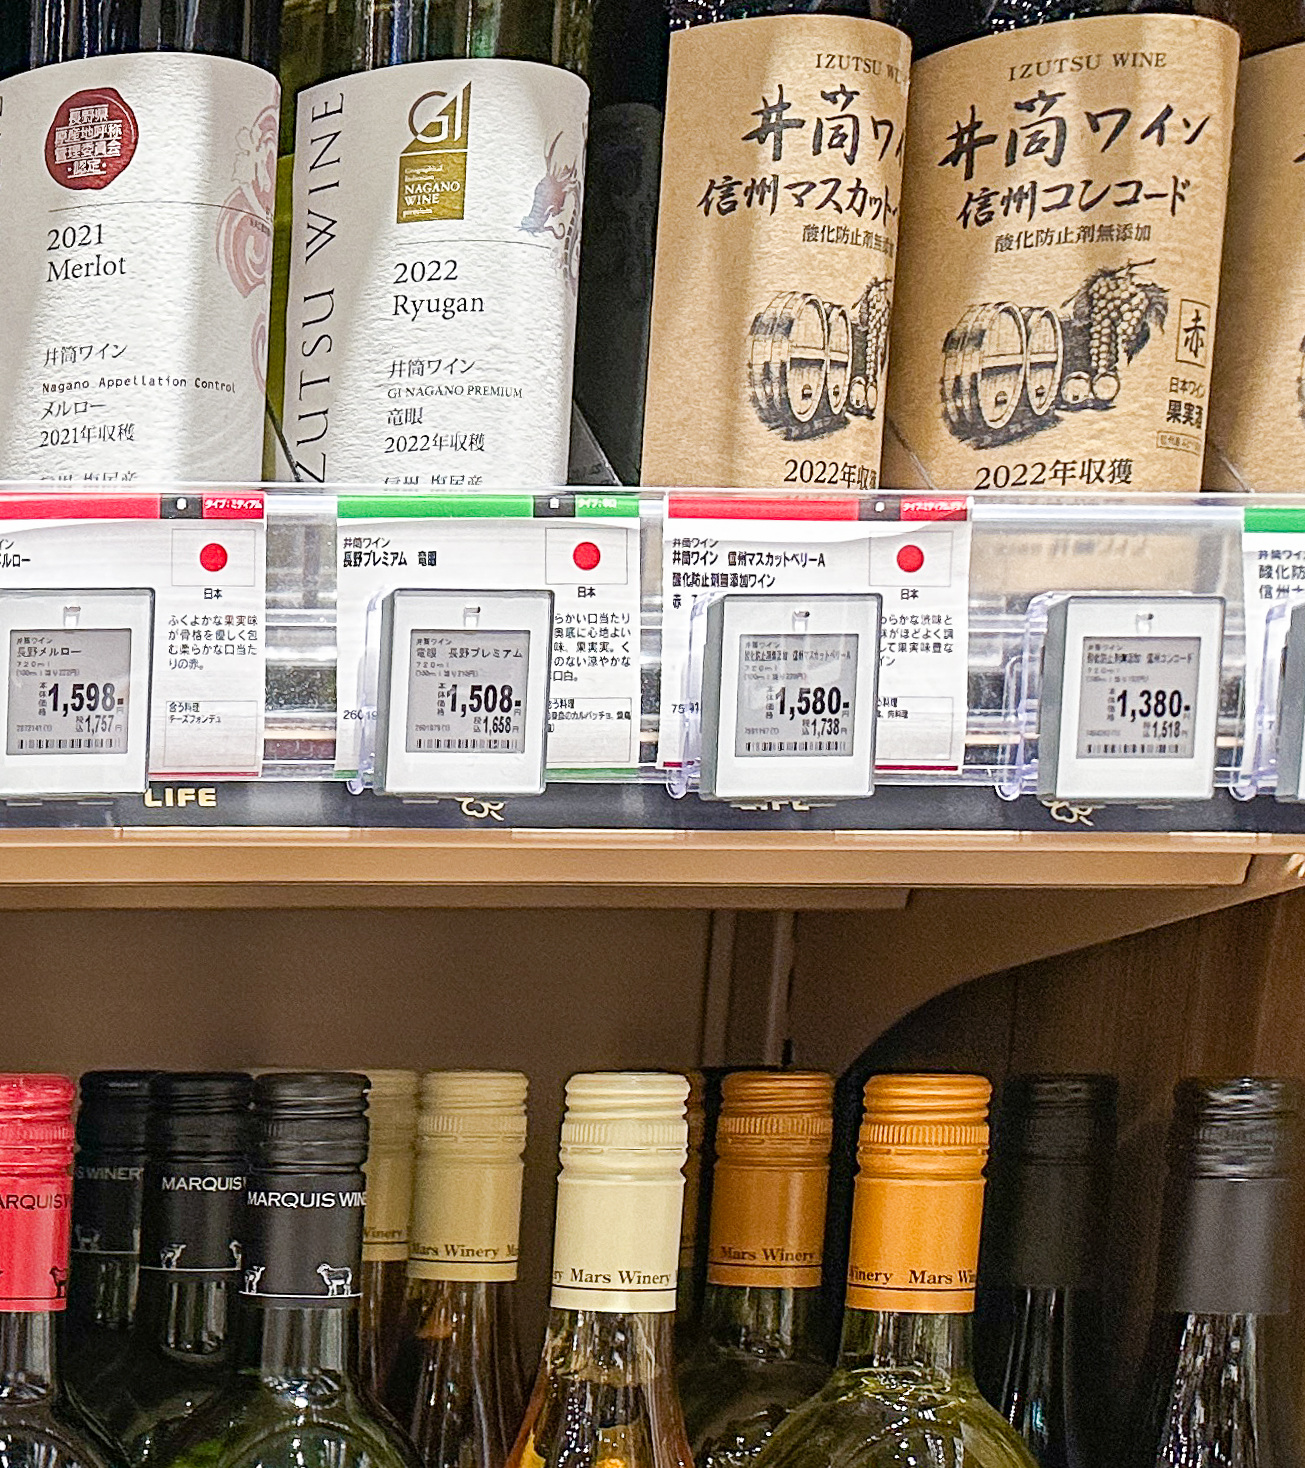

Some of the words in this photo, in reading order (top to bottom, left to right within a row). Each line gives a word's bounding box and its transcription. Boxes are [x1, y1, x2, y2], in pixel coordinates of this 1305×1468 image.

[1008, 56, 1102, 81] IZUTSU
[1112, 51, 1167, 69] WINE
[937, 91, 1209, 180] 井筒ワイン
[404, 183, 461, 196] NAGANO
[957, 176, 1191, 230] 信州コンコード
[46, 223, 104, 252] 2021
[993, 223, 1151, 254] 酸化防止剤無添加
[46, 254, 126, 284] Merlot
[393, 259, 459, 285] 2022
[392, 293, 485, 318] Ryugan
[44, 343, 126, 367] 井筒ワイン
[388, 357, 475, 379] 井筒ワイン
[42, 378, 90, 394] Nagano
[99, 375, 187, 390] Appellation
[195, 377, 236, 394] Control
[40, 400, 106, 420] メルロー
[387, 406, 424, 425] 竜眼
[39, 423, 135, 448] 2021年収穫
[384, 432, 485, 453] 2022年収穫
[343, 537, 390, 548] 井筒ワイン
[672, 551, 718, 566] 井筒ワイン
[728, 552, 825, 568] 信州マスカットベリーA
[48, 682, 116, 717] 1,598
[449, 683, 513, 717] 1,508
[776, 687, 841, 720] 1,580
[1117, 690, 1182, 722] 1,380
[144, 788, 217, 807] LIFE
[162, 1176, 243, 1192] MARQUIS
[570, 1269, 612, 1284] Mars
[618, 1269, 670, 1288] Winery
